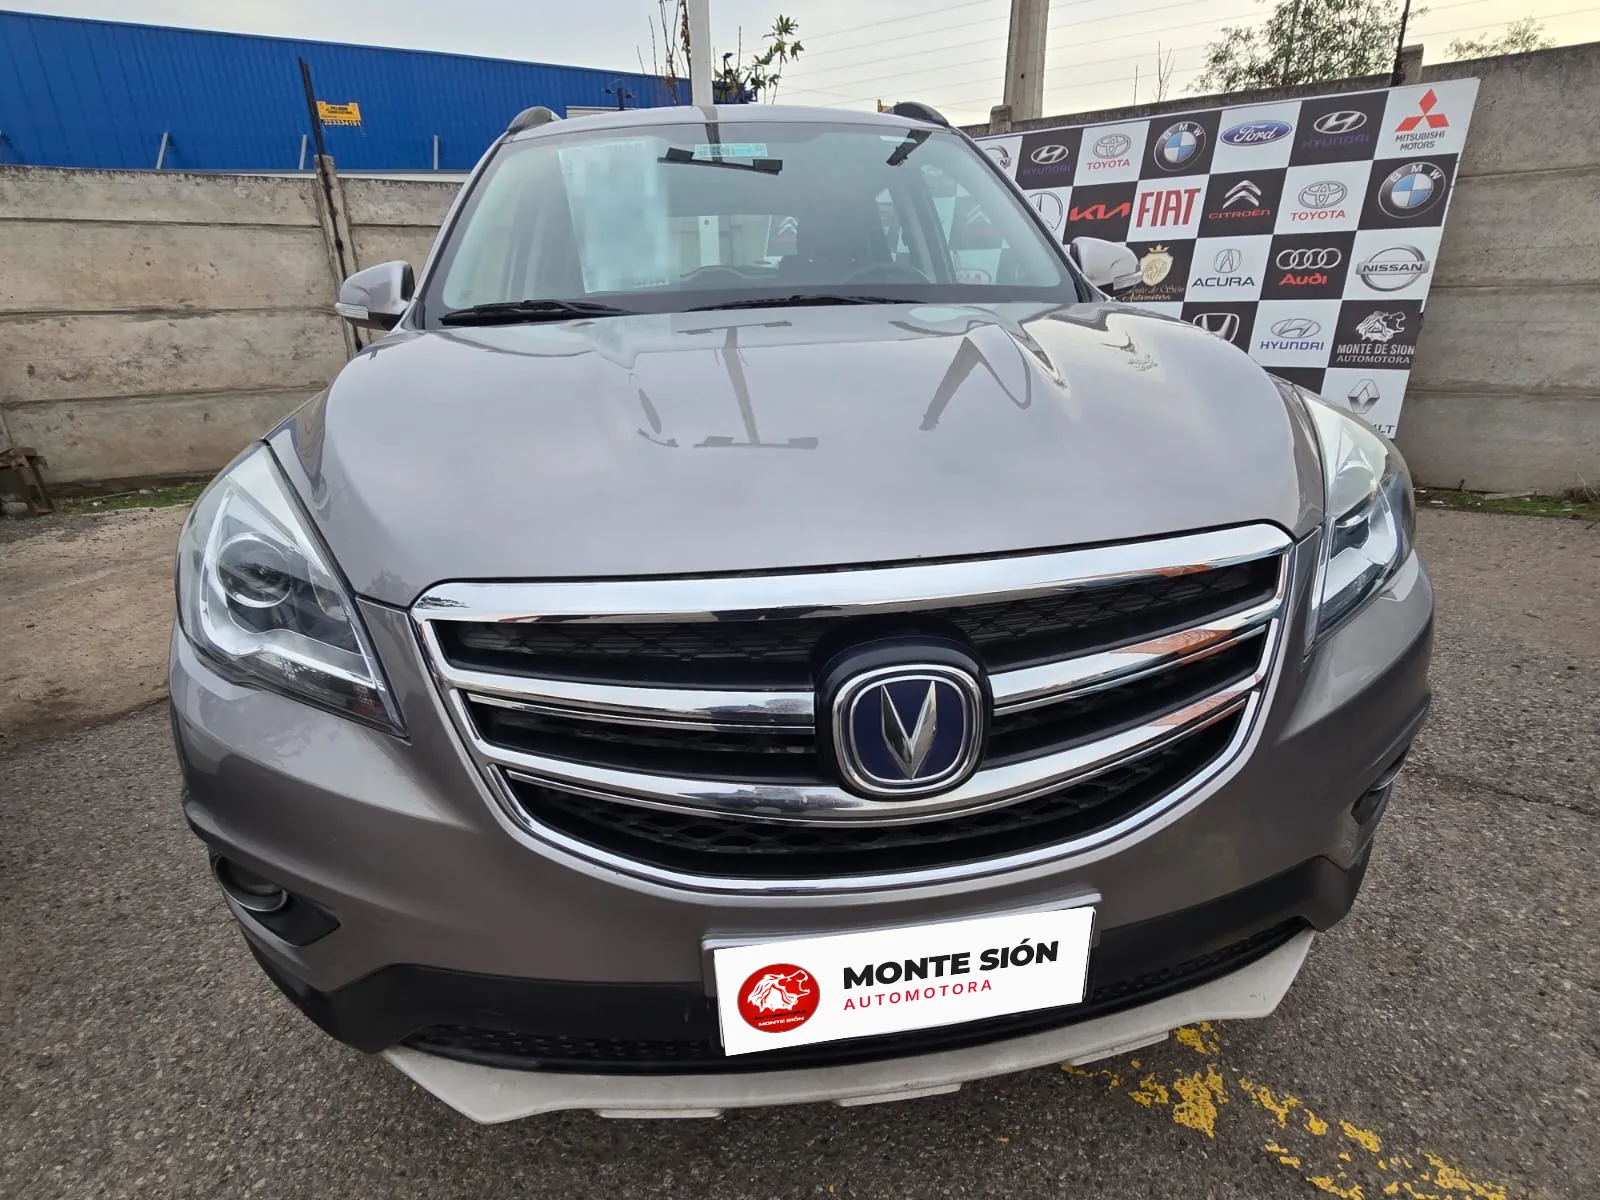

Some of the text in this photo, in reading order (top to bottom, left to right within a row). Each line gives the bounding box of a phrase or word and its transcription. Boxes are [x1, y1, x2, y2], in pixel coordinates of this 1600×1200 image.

[1162, 123, 1202, 140] BMW
[1233, 124, 1276, 142] Ford
[1395, 131, 1446, 143] MITSUBISHI
[1302, 133, 1371, 149] HYUNDAI
[1400, 141, 1435, 151] MOTORS
[1087, 158, 1130, 171] TOYOTA
[1022, 165, 1071, 177] HYUNDAI
[1390, 164, 1442, 183] BMW
[1069, 202, 1131, 221] KIA
[1136, 188, 1201, 228] FIAT
[1290, 210, 1346, 222] TOYOTA
[1362, 263, 1423, 273] NISSAN
[1191, 276, 1255, 288] ACURA
[1279, 272, 1329, 286] Audi
[1260, 341, 1325, 351] HYUNDAI
[1336, 343, 1416, 355] MONTE DE SION
[1336, 354, 1411, 364] AUTOMOTORA
